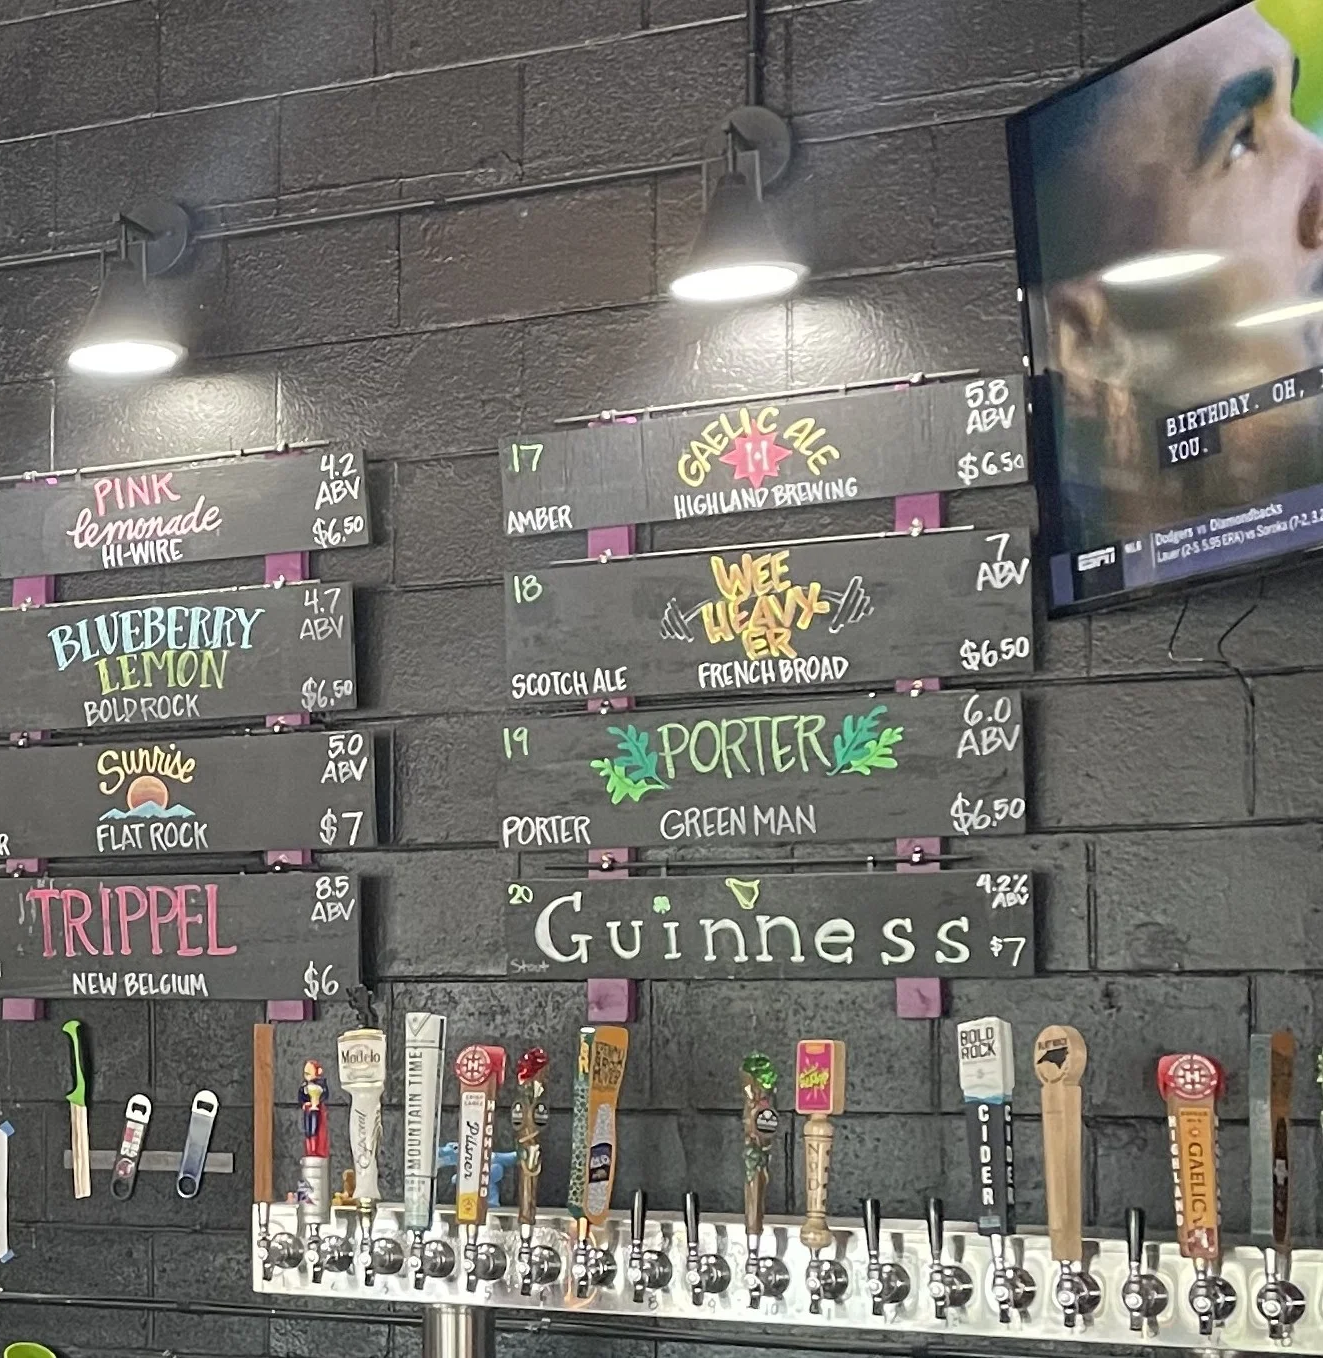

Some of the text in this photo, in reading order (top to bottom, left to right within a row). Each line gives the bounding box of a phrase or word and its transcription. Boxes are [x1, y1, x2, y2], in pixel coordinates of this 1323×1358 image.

[965, 379, 1009, 409] 5.8
[1167, 378, 1305, 436] BIRTHDAY. OH,
[966, 405, 1015, 434] ABV
[511, 443, 544, 474] 17
[677, 406, 780, 488] GAELIC
[1169, 437, 1209, 463] YOU.
[320, 453, 357, 480] 4.2
[93, 472, 181, 516] PINK
[314, 476, 361, 510] ABV
[673, 477, 858, 519] HIGHLAND BREWING
[66, 496, 222, 549] lemonade
[312, 515, 364, 549] $6.50
[506, 505, 573, 534] AMBER
[1155, 503, 1283, 546] Dodgers Diamondbacks
[102, 539, 184, 569] HI-WIRE
[985, 533, 1011, 561] 7
[513, 574, 543, 603] 18
[711, 550, 792, 601] WEE
[977, 558, 1029, 592] ABV
[304, 587, 341, 614] 4.7
[48, 606, 265, 671] BLUEBERRY
[299, 615, 343, 641] ABV
[742, 627, 797, 660] ER
[959, 636, 1029, 670] $6.50
[94, 649, 230, 695] LEMON
[511, 666, 628, 699] SCOTCH ALE
[698, 655, 849, 689] FRENCH BROAD
[301, 676, 353, 713] $6.50
[963, 695, 1012, 726] 6.0
[503, 727, 529, 759] 19
[656, 714, 833, 778] PORTER
[957, 724, 1020, 758] ABV
[97, 743, 196, 795] Sunrise
[321, 757, 368, 784] ABV
[659, 804, 816, 840] GREEN MAN
[950, 792, 1025, 835] $6.50
[96, 822, 209, 853] FLAT ROCK
[502, 815, 591, 848] PORTER
[315, 876, 350, 900] 8.5
[507, 883, 533, 904] 20
[976, 874, 1028, 894] 4.2%
[992, 892, 1029, 908] ABV
[26, 884, 237, 958] TRIPPEL
[311, 899, 356, 922] ABV
[533, 891, 971, 966] Guinness
[510, 958, 550, 974] Stout
[990, 936, 1026, 966] $7
[72, 972, 208, 997] NEW BELGIUM
[304, 961, 340, 1000] $6
[960, 1027, 994, 1046] BOLD
[961, 1041, 996, 1060] ROCK
[341, 1051, 380, 1064] Modelo
[409, 1052, 423, 1086] TIME
[408, 1093, 422, 1170] MOUNTAIN
[464, 1121, 480, 1179] Pilsner
[480, 1100, 495, 1197] HIGHLAND
[978, 1104, 994, 1205] CIDER
[1188, 1142, 1207, 1216] GAELIC
